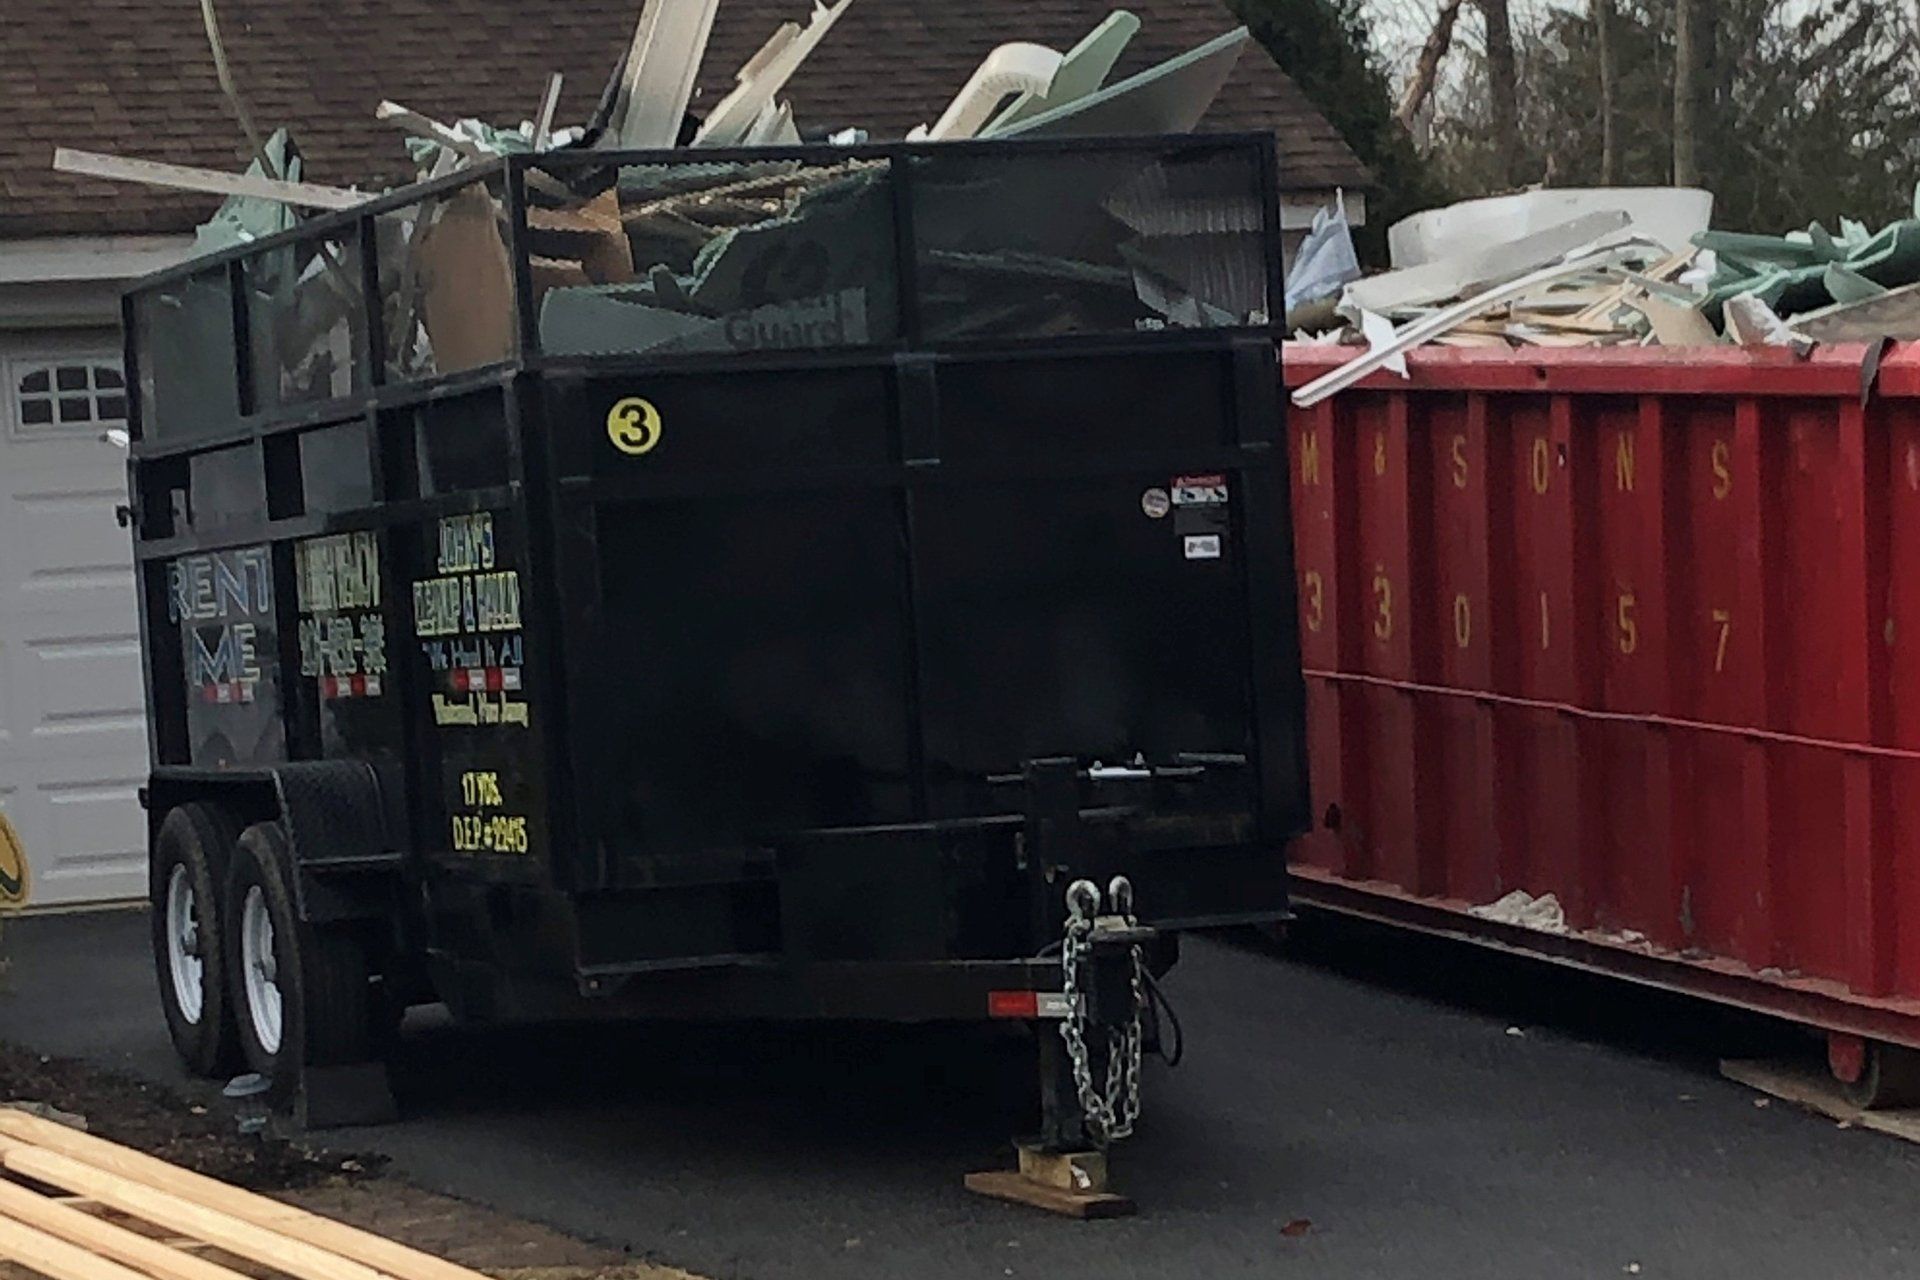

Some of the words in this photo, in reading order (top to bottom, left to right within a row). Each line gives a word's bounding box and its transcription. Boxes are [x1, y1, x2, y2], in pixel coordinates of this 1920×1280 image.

[618, 403, 650, 446] 3
[166, 549, 269, 624] RENT
[191, 622, 261, 686] ME
